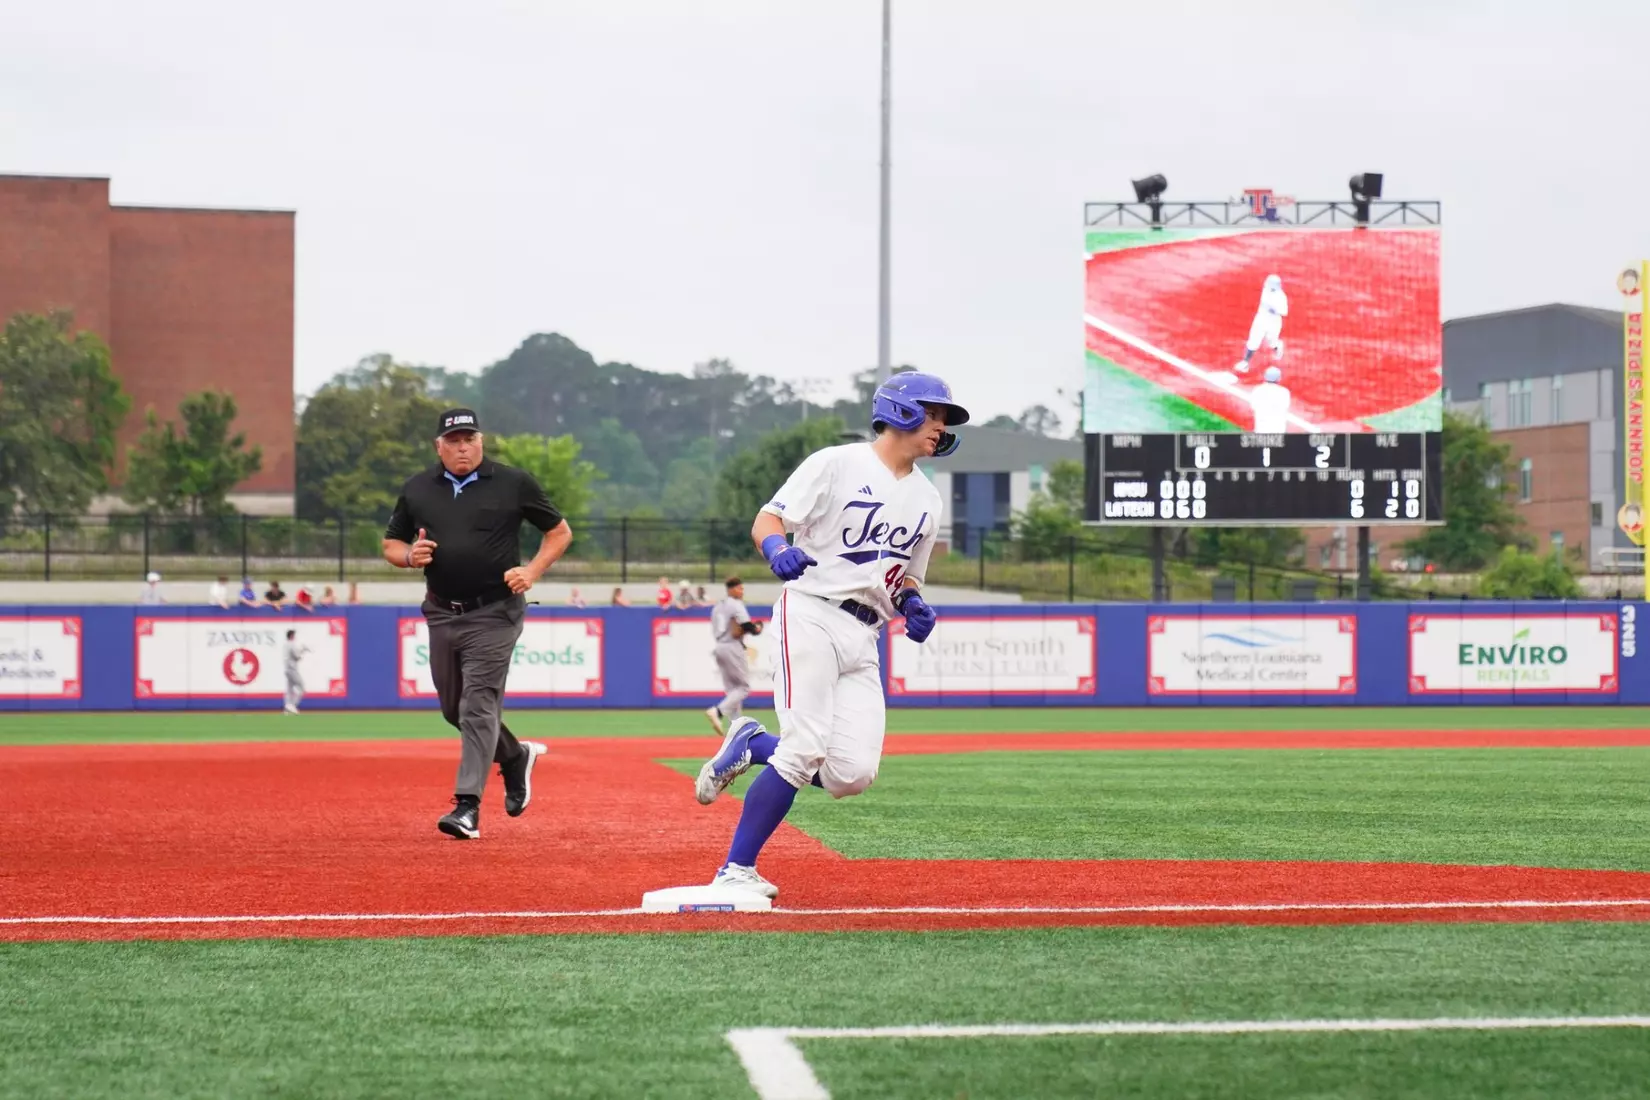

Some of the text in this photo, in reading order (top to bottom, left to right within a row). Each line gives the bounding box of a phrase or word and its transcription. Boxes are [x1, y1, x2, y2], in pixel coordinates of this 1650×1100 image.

[1195, 446, 1331, 469] 0 1 2
[1350, 480, 1365, 498] 0
[1350, 499, 1365, 518] 6
[842, 500, 928, 551] Tech
[512, 645, 585, 666] Foods
[985, 637, 1066, 657] Smith
[1458, 643, 1568, 665] ENVIRO
[917, 660, 1068, 674] FURNITURE
[1197, 668, 1308, 682] Medical Center
[1477, 668, 1550, 682] RENTALS
